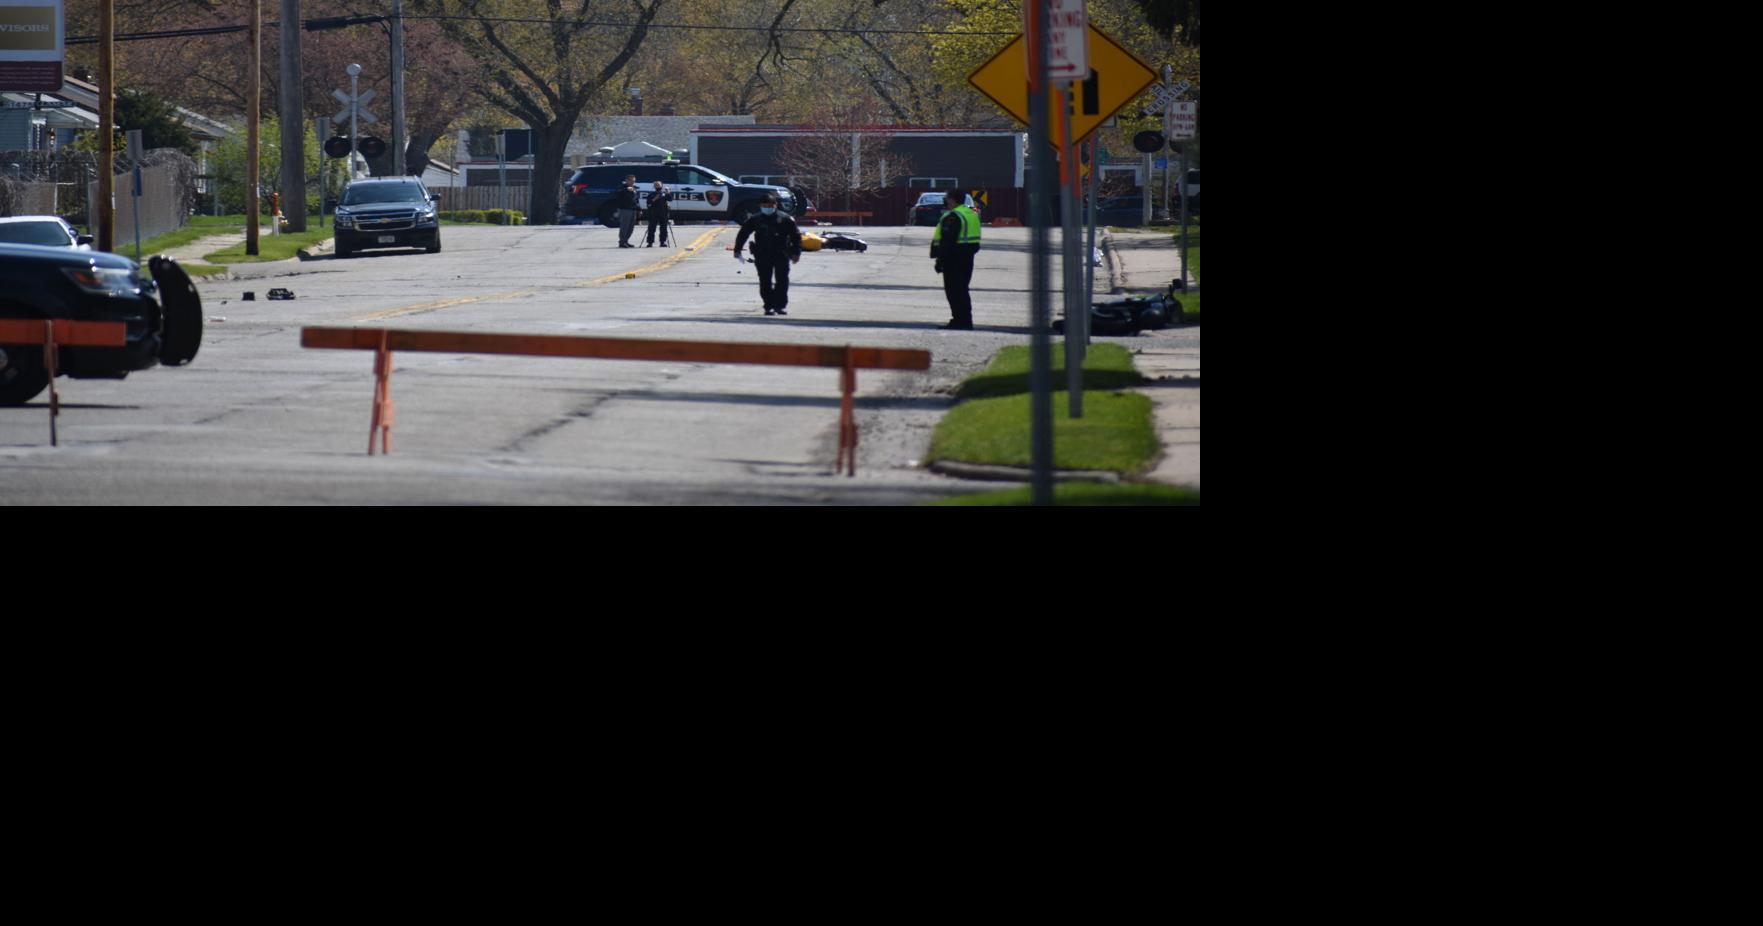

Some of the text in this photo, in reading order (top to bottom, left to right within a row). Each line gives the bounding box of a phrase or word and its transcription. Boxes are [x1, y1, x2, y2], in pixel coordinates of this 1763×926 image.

[1147, 81, 1188, 113] CROSSING
[1180, 103, 1188, 111] NO
[640, 191, 699, 200] PICE
